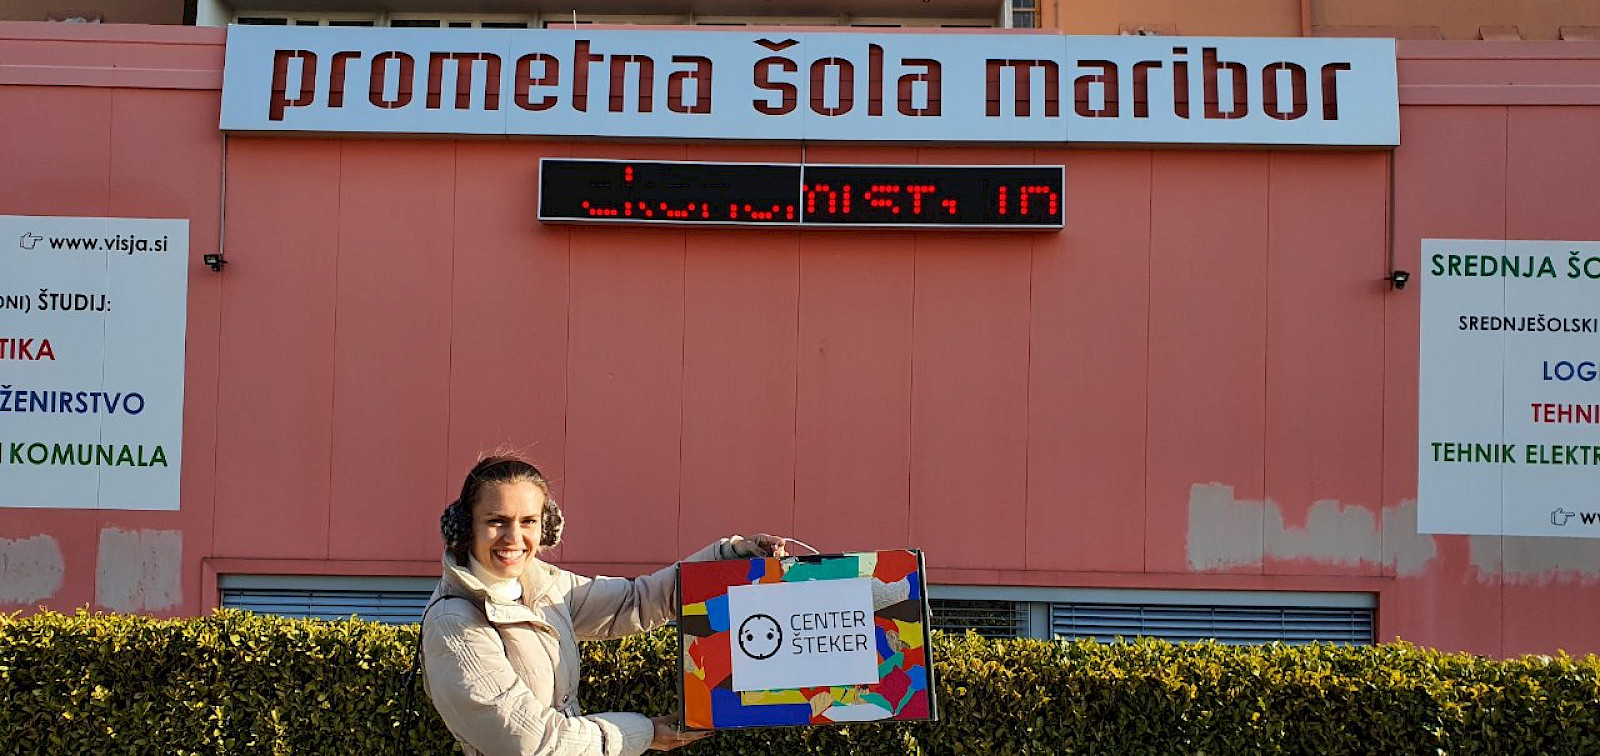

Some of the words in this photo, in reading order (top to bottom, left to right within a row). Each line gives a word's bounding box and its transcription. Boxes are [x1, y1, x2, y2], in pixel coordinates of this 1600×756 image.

[269, 40, 713, 121] prometna
[753, 39, 942, 117] šola
[985, 46, 1352, 120] maribor
[49, 234, 168, 255] www.visja.si
[1431, 254, 1557, 279] SREDNJA
[1567, 250, 1600, 279] ŠO
[38, 288, 111, 312] ŠTUDIJ:
[1459, 313, 1598, 333] SREDNJEŠOLSKI
[0, 338, 56, 361] TIKA
[1543, 360, 1600, 382] LOG
[0, 384, 145, 415] ŽENIRSTVO
[1531, 403, 1600, 424] TEHNI
[9, 442, 168, 467] KOMUNALA
[1431, 442, 1516, 463] TEHNIK
[790, 610, 866, 632] CENTER
[791, 632, 868, 655] ŠTEKER
